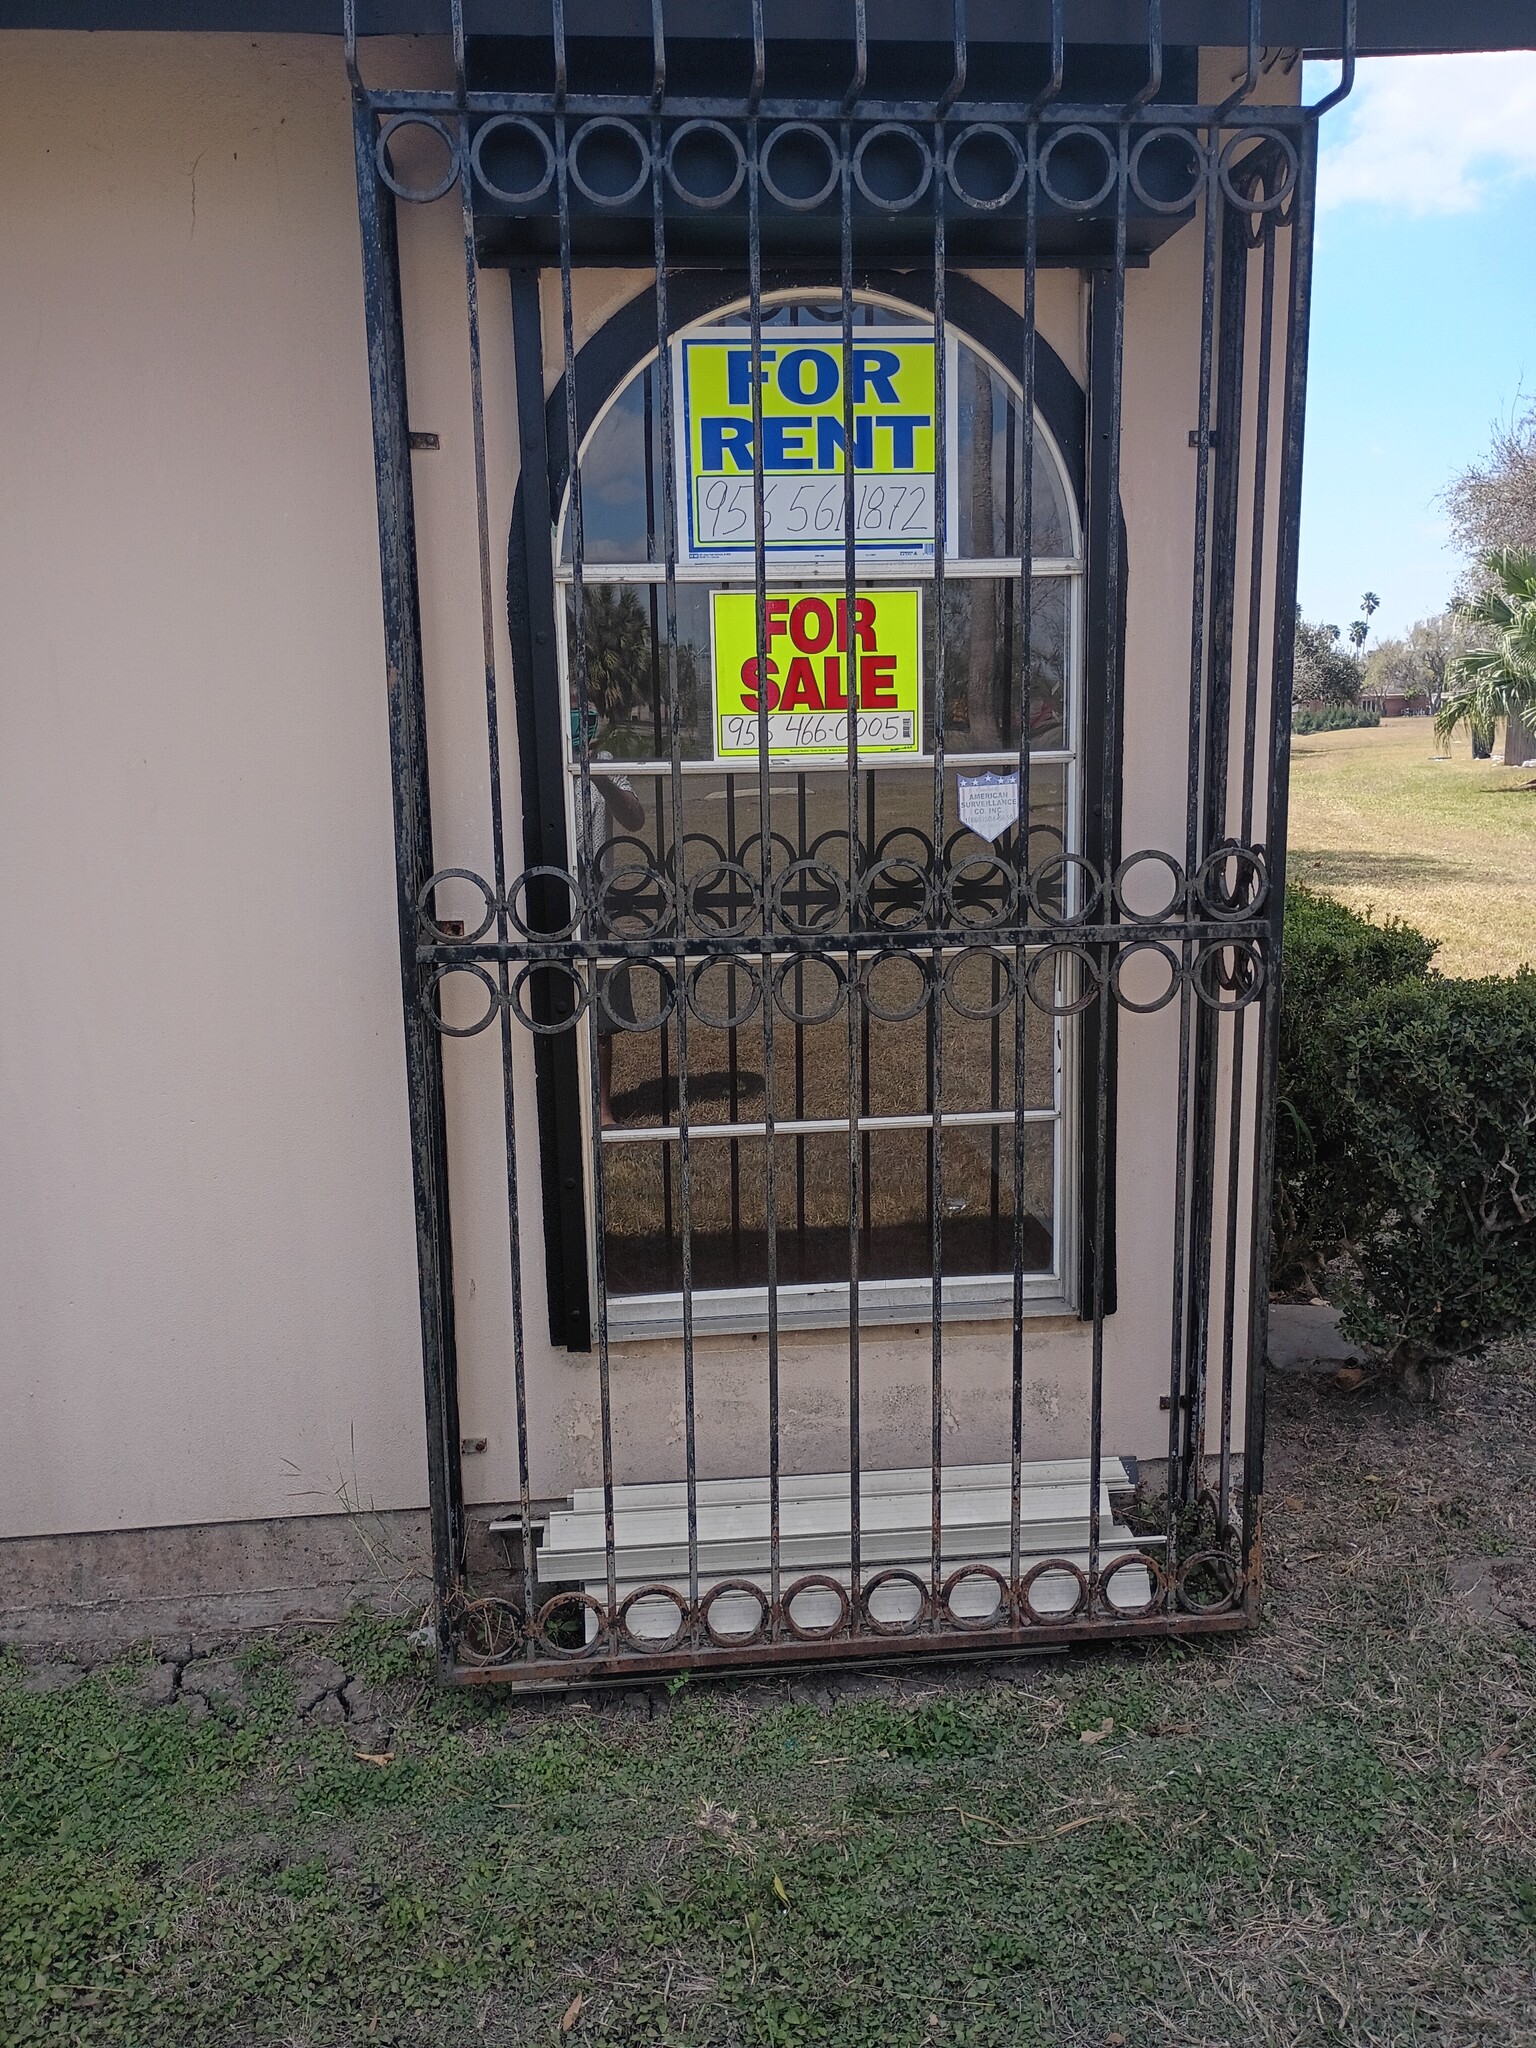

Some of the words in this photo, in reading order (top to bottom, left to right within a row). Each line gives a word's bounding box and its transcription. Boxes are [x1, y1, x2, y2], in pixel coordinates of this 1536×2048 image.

[727, 349, 900, 405] FOR
[700, 415, 931, 471] RENT
[755, 597, 878, 654] FOR
[740, 655, 898, 712] SALE
[961, 799, 1017, 809] SURVEILLANCE
[969, 791, 1008, 800] AMERICAN
